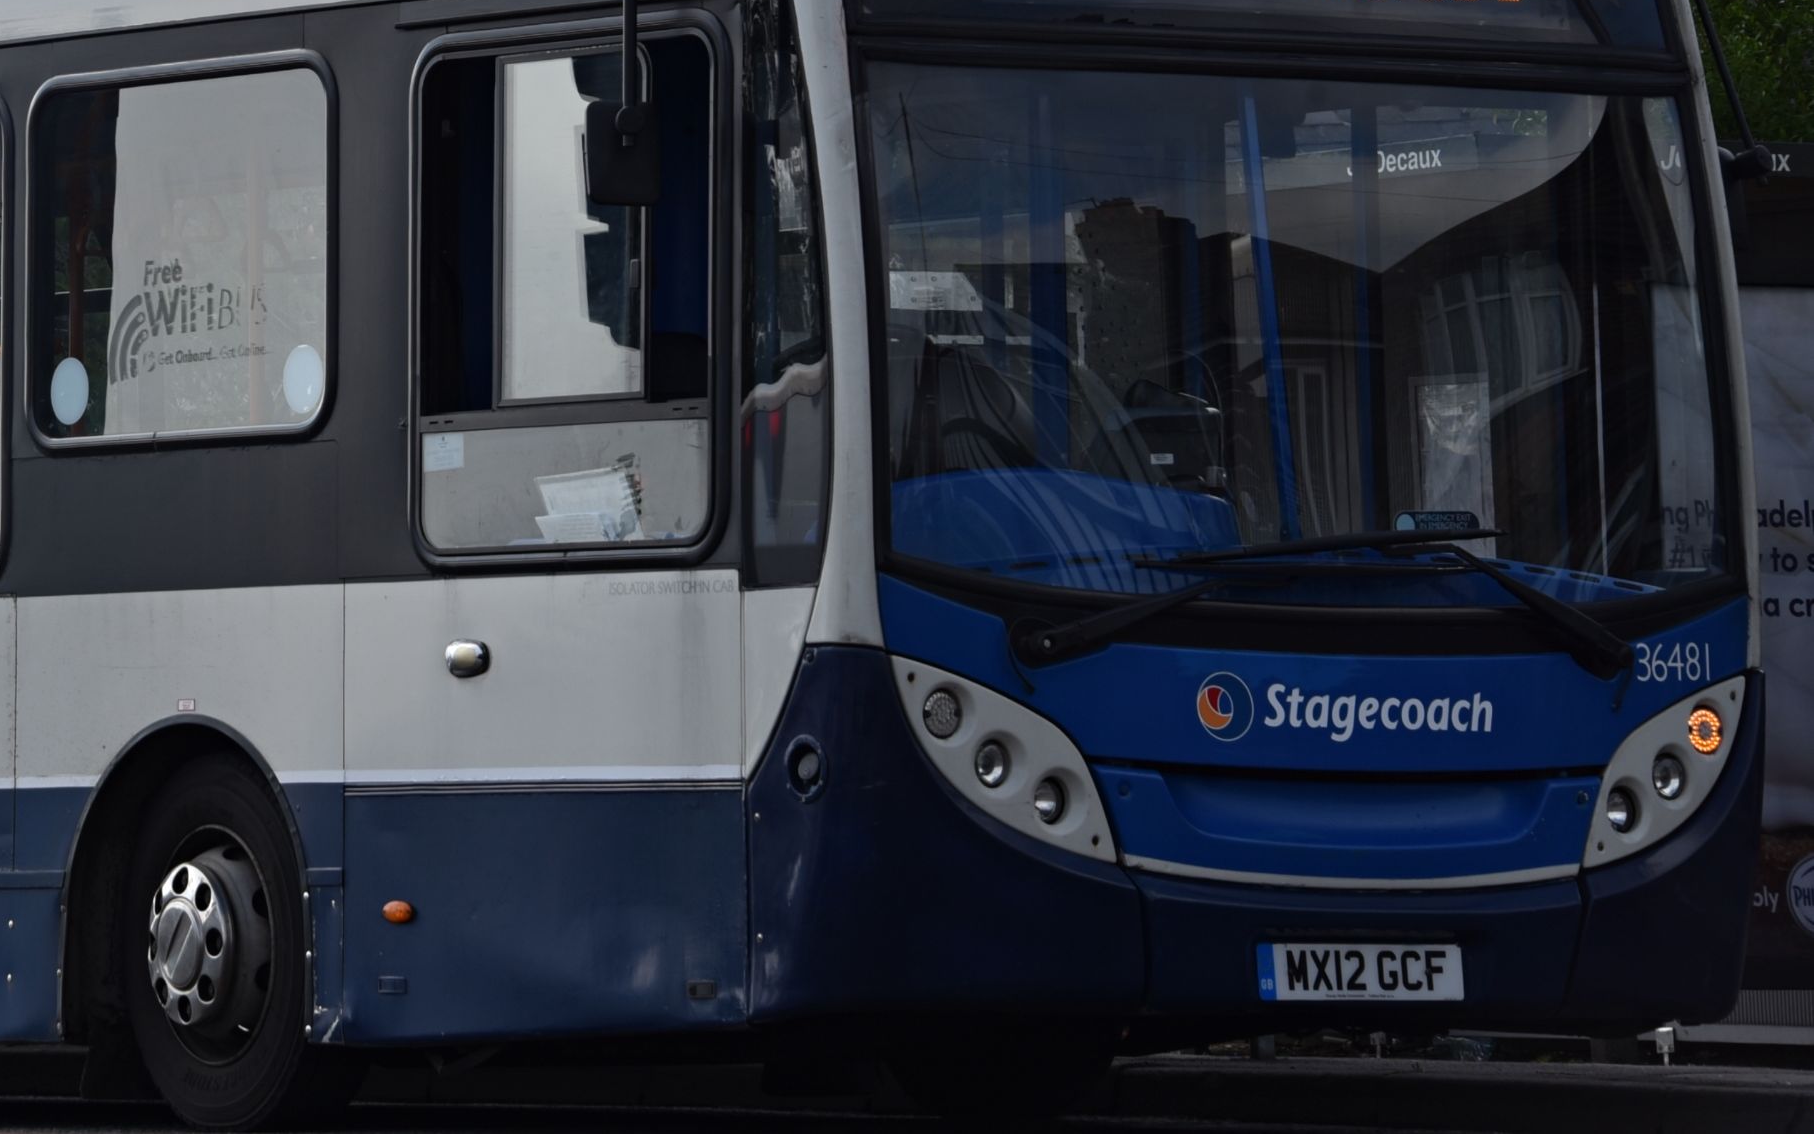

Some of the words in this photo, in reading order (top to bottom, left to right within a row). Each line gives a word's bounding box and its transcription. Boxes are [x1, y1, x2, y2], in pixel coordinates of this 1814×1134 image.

[143, 258, 183, 286] Free
[1771, 547, 1798, 572] to
[608, 582, 655, 595] ISOLATOR
[1636, 642, 1710, 682] 36481
[1264, 683, 1493, 742] Stagecoach
[1260, 978, 1274, 991] GB
[1286, 950, 1367, 991] MX12
[1376, 950, 1446, 991] GCF
